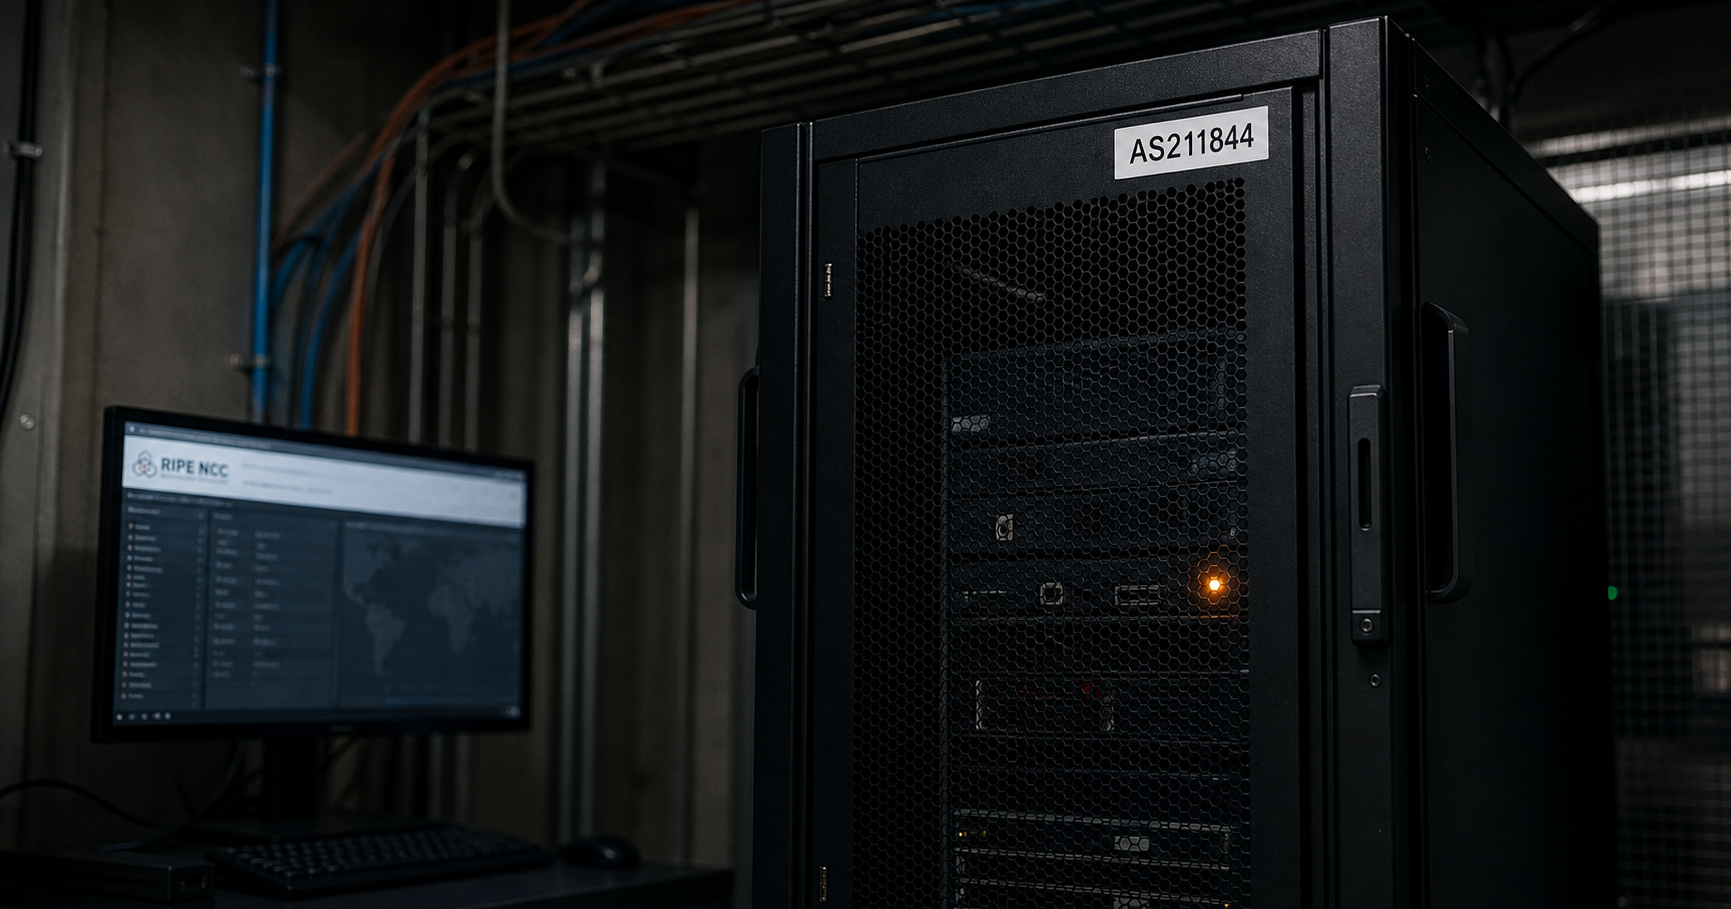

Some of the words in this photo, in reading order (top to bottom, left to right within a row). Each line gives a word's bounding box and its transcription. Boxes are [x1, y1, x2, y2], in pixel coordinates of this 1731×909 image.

[1129, 122, 1254, 164] AS211844
[161, 457, 195, 474] RIPE
[199, 461, 229, 478] NCC
